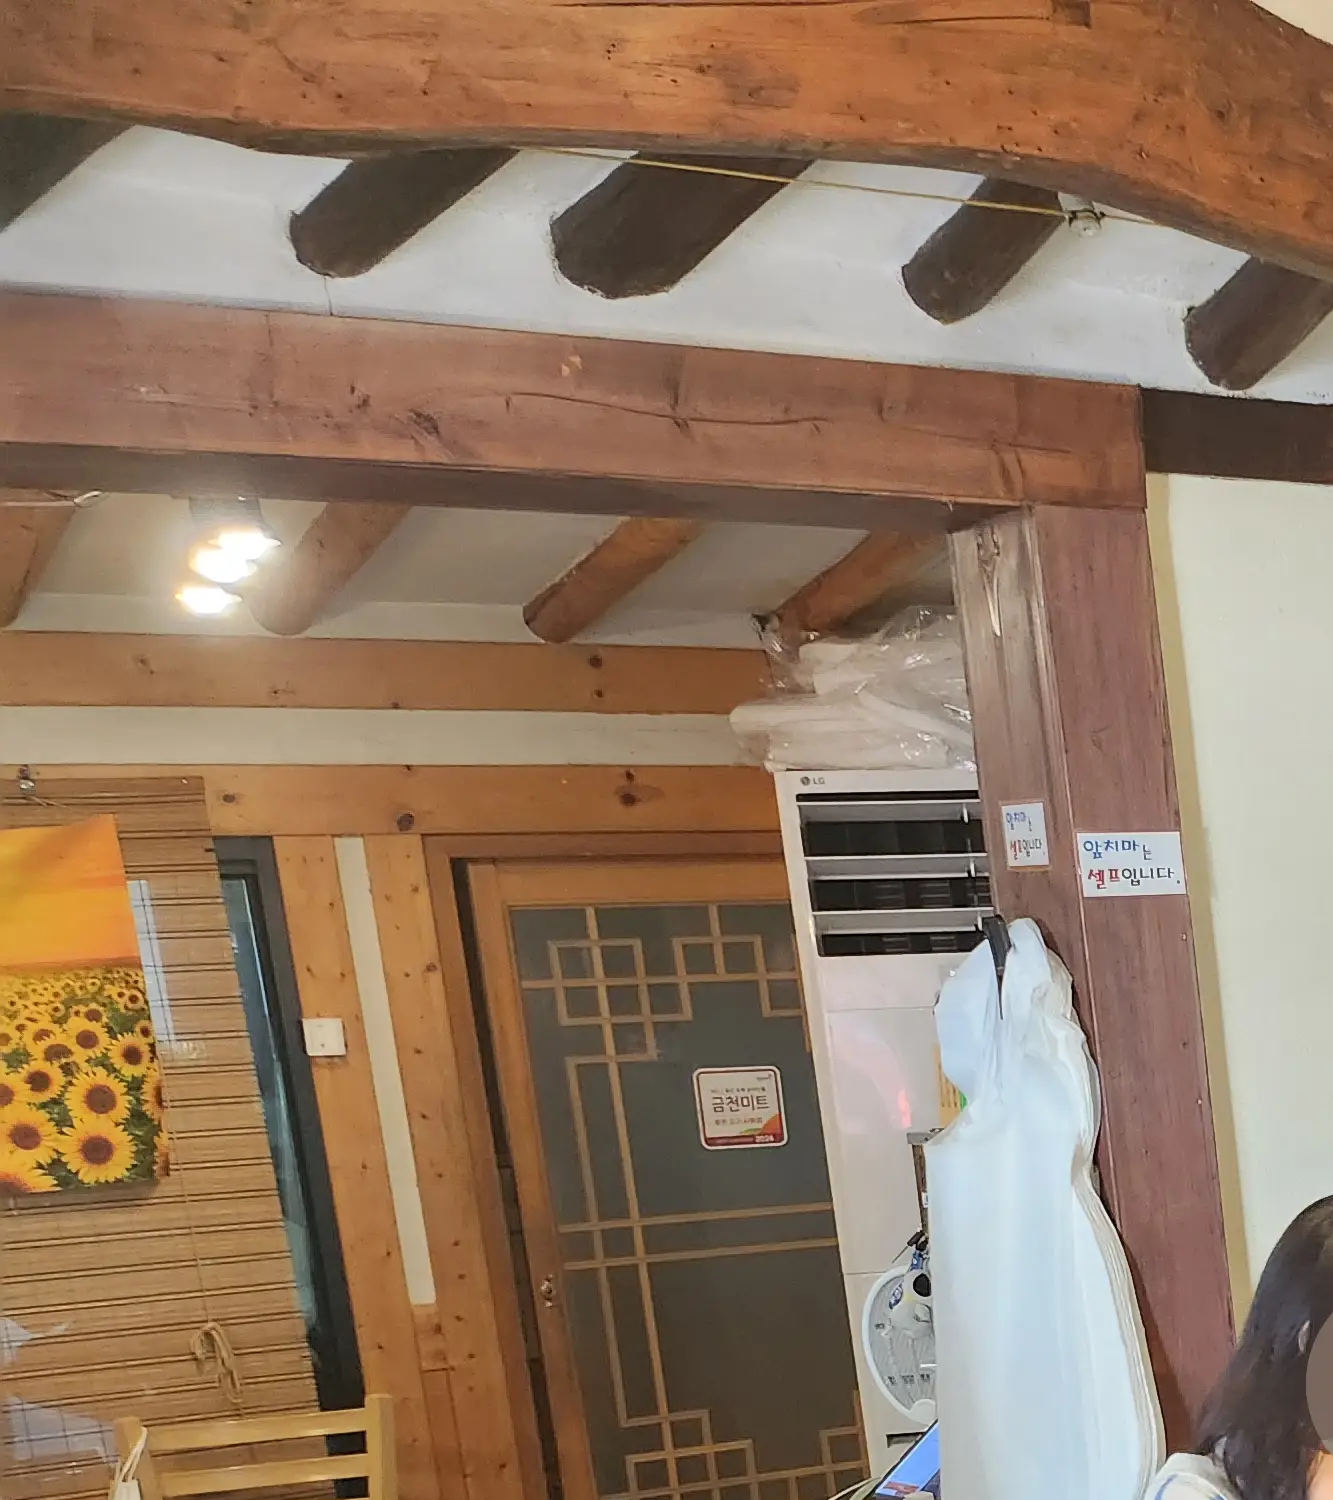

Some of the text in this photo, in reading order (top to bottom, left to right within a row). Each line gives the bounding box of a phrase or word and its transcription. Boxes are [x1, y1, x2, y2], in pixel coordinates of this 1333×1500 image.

[1083, 840, 1152, 860] 앞치마는
[1088, 867, 1181, 890] 셀프입니다.
[712, 1095, 770, 1113] 금천미트
